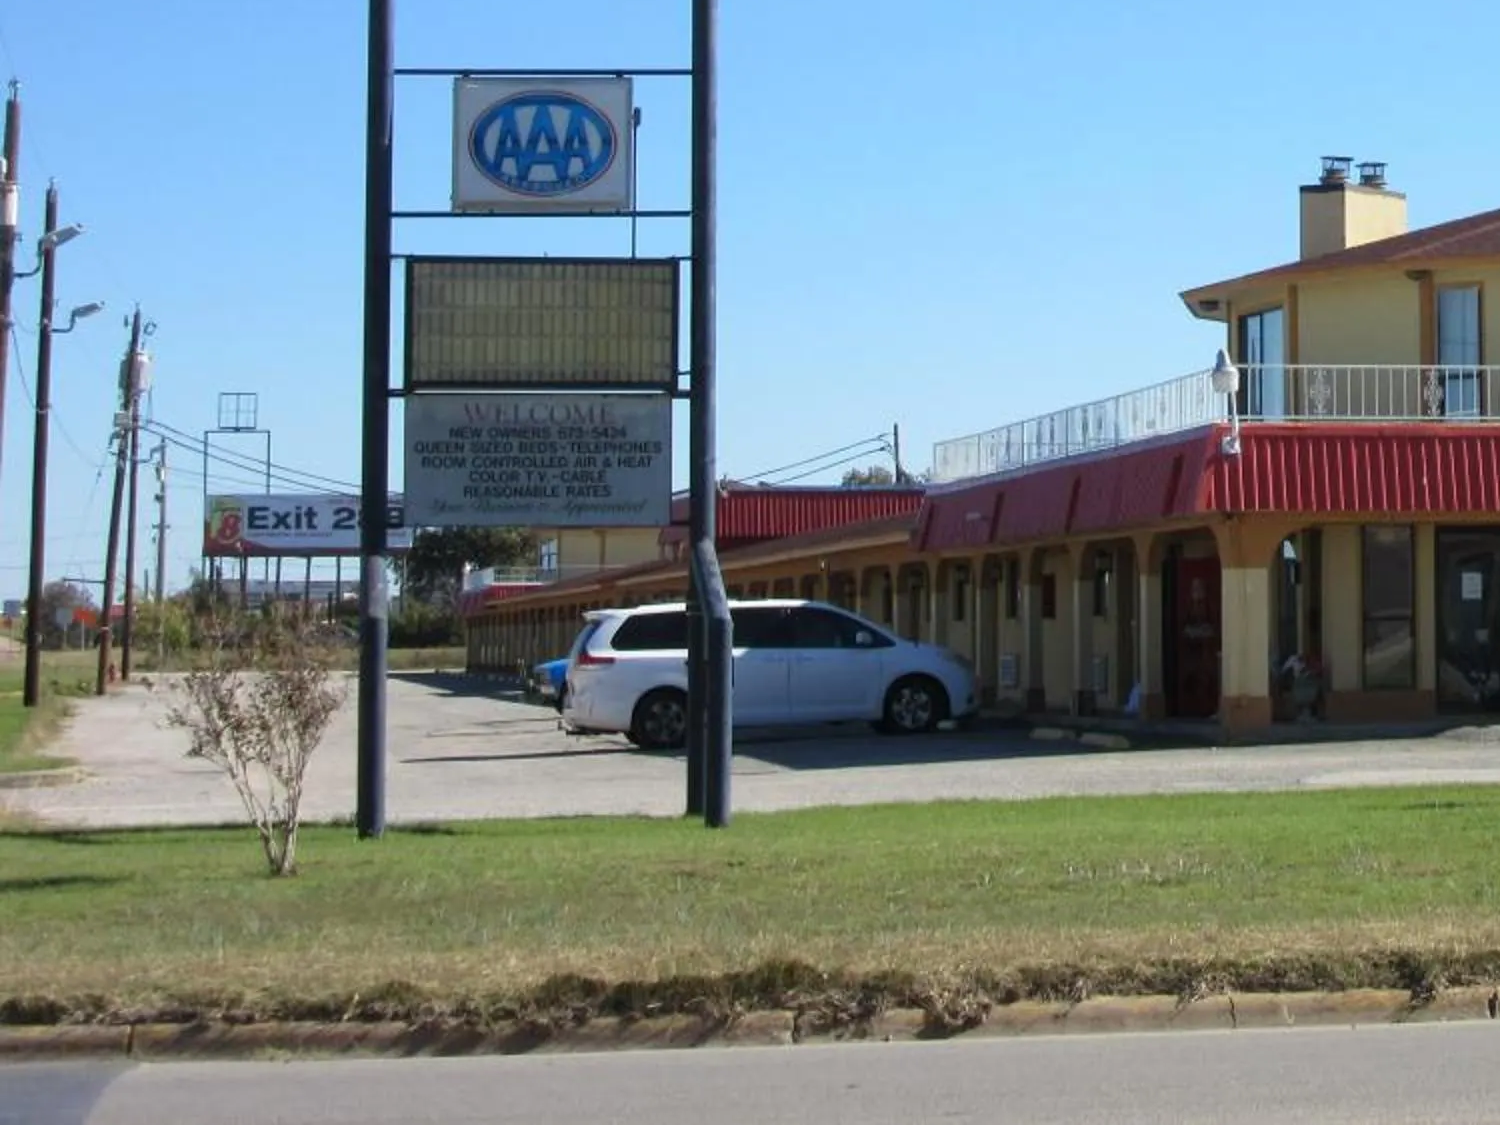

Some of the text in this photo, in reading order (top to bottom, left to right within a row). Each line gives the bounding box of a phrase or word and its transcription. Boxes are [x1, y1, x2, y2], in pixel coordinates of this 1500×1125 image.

[489, 103, 593, 182] AAA
[464, 402, 615, 424] WELCOME
[449, 426, 483, 439] NEW
[487, 426, 551, 439] OWNERS
[414, 441, 465, 454] QUEEN
[470, 441, 513, 453] SIZED
[421, 456, 653, 468] ROOM CONTROLLED AIR & HEAT
[469, 470, 520, 483] COLOR
[463, 485, 612, 499] REASONABLE RATES
[248, 506, 318, 530] Exit
